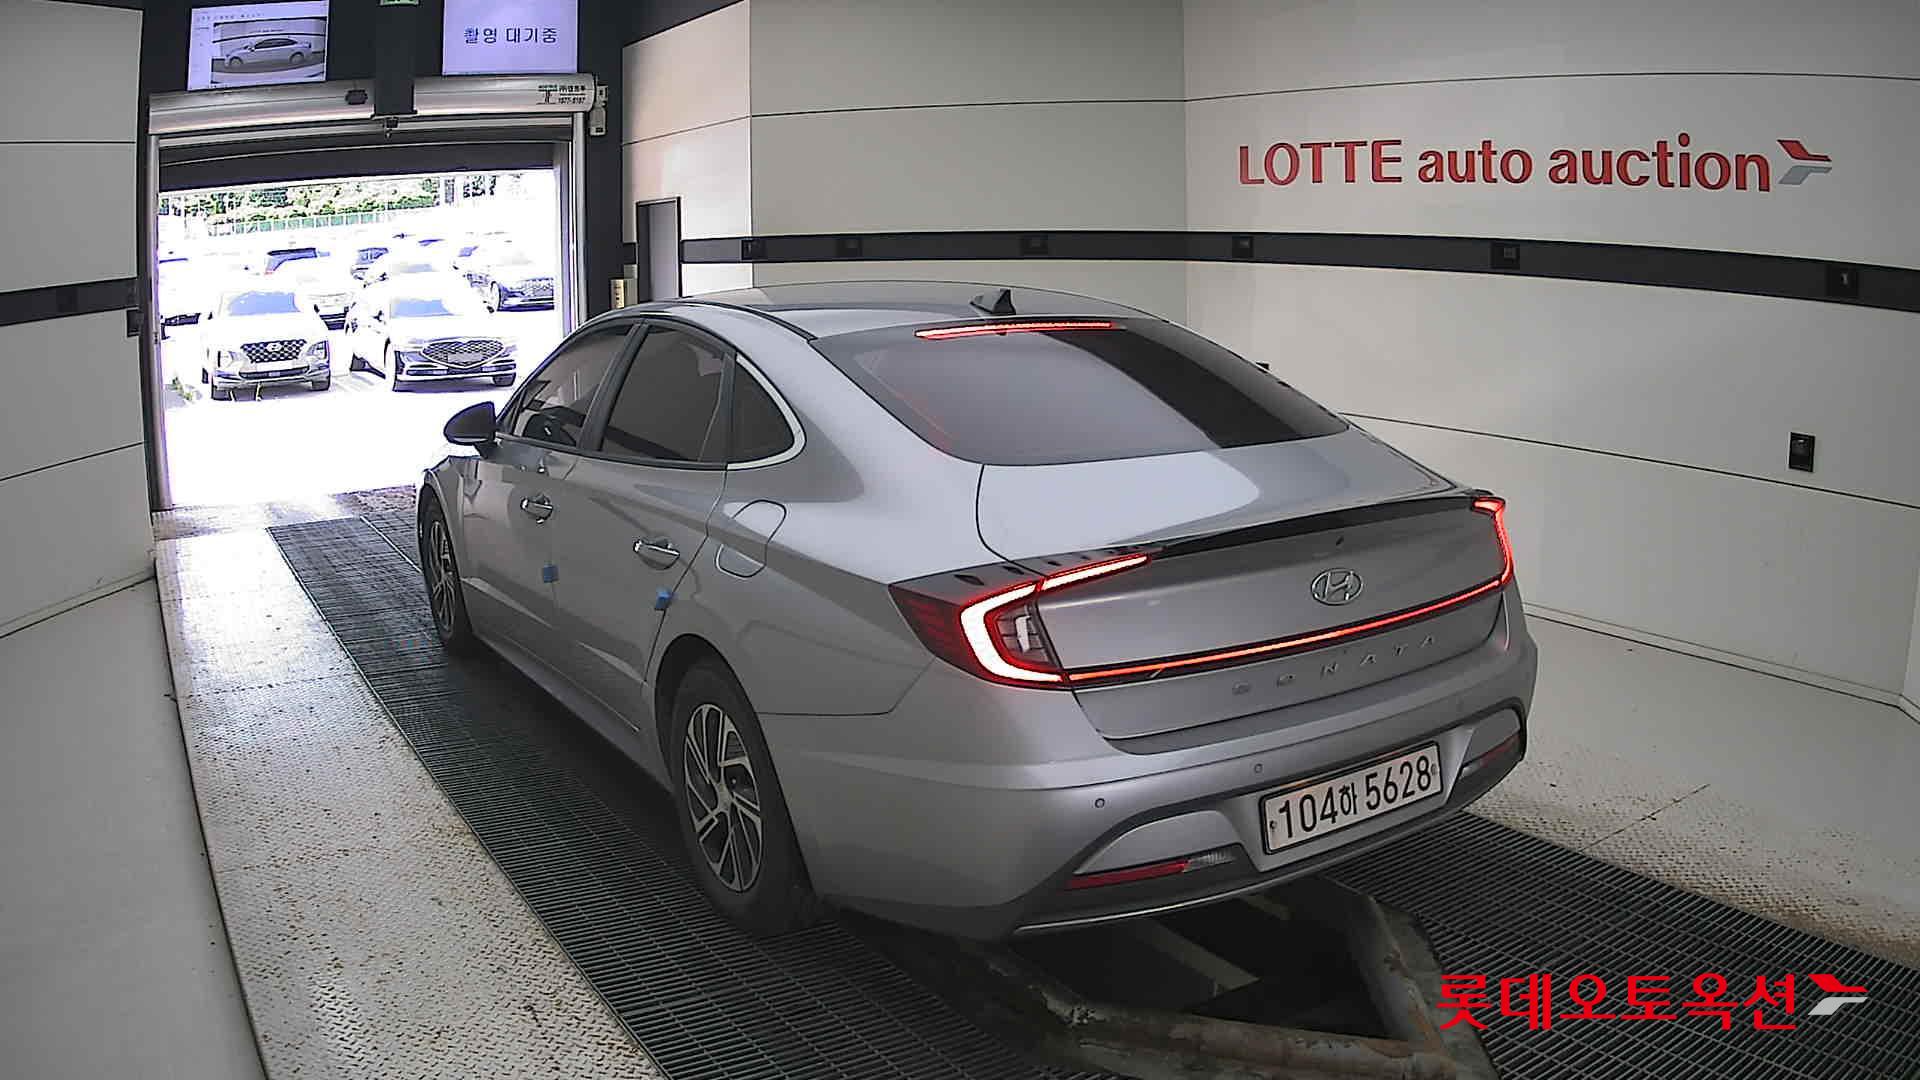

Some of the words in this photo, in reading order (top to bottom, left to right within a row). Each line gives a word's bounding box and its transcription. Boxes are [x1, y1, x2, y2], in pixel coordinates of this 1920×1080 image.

[506, 27, 558, 43] 대기중
[1238, 139, 1402, 186] LOTTE
[1417, 140, 1534, 184] auto
[1548, 133, 1772, 192] auction
[1278, 782, 1358, 839] 104하
[1364, 755, 1432, 811] 5628
